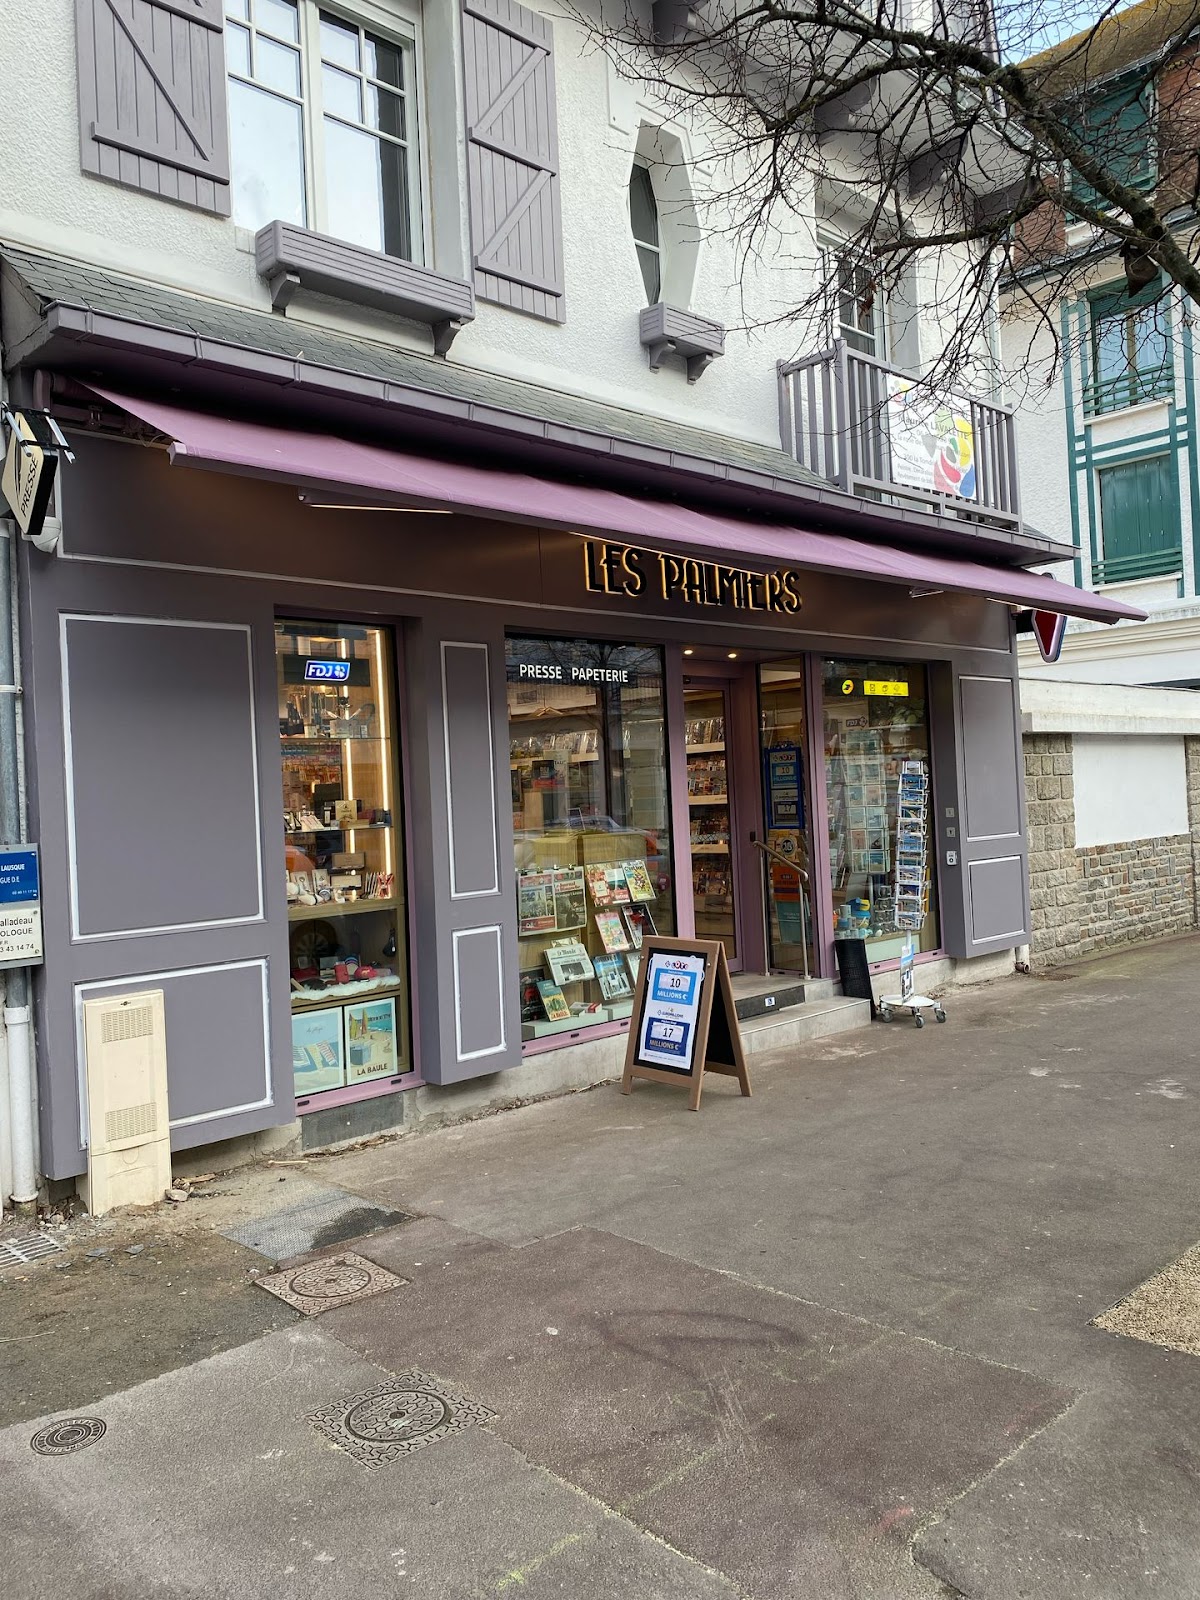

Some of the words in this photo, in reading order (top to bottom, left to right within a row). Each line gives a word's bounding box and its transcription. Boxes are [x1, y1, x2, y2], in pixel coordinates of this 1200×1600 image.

[21, 454, 38, 517] PRESSE
[583, 541, 647, 597] LES
[658, 552, 803, 614] PALMIERS
[308, 664, 333, 678] FDJ
[519, 664, 562, 680] PRESSE
[571, 667, 629, 683] PAPETERIE
[670, 978, 681, 988] 10
[657, 990, 682, 1000] MILLIONS
[662, 1027, 674, 1038] 17
[649, 1039, 674, 1050] MILLIONS
[367, 1063, 388, 1074] BAULE
